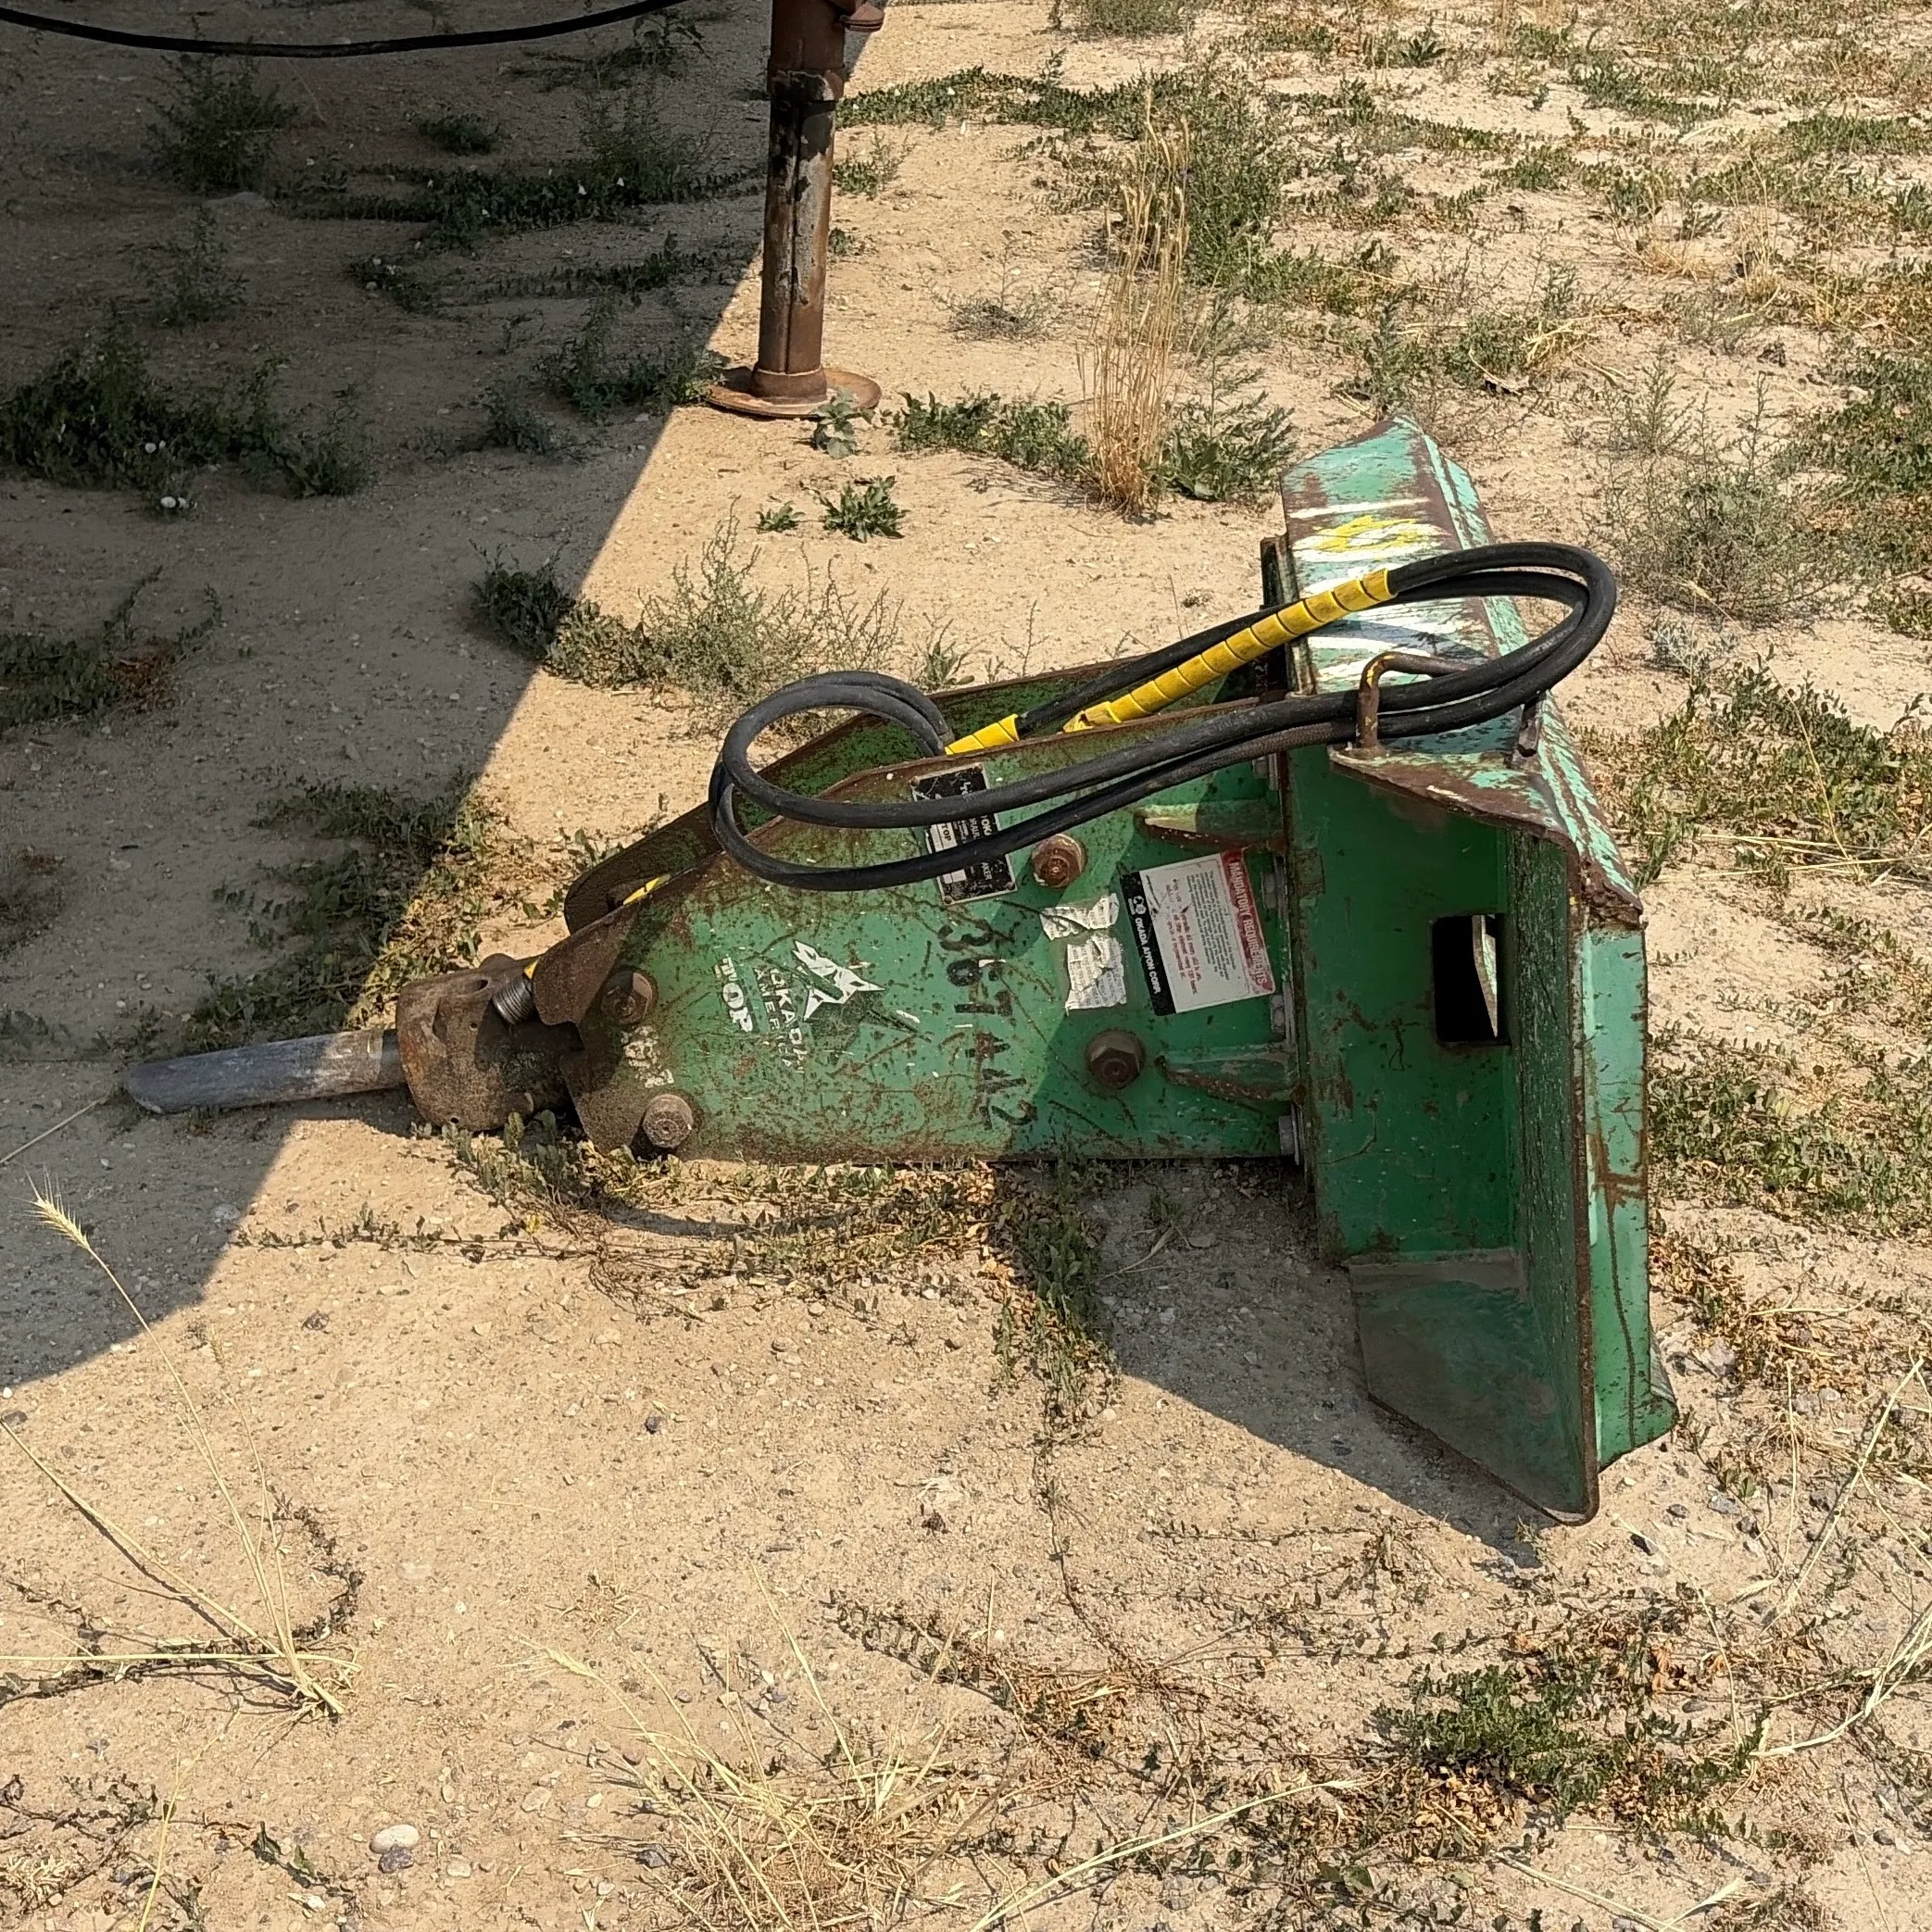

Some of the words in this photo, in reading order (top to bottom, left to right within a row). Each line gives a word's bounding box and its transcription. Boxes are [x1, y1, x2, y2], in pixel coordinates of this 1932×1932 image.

[1135, 917, 1148, 946] OKADA
[1228, 862, 1253, 918] MANDATORY
[1242, 916, 1268, 986] REQUIREMENTS
